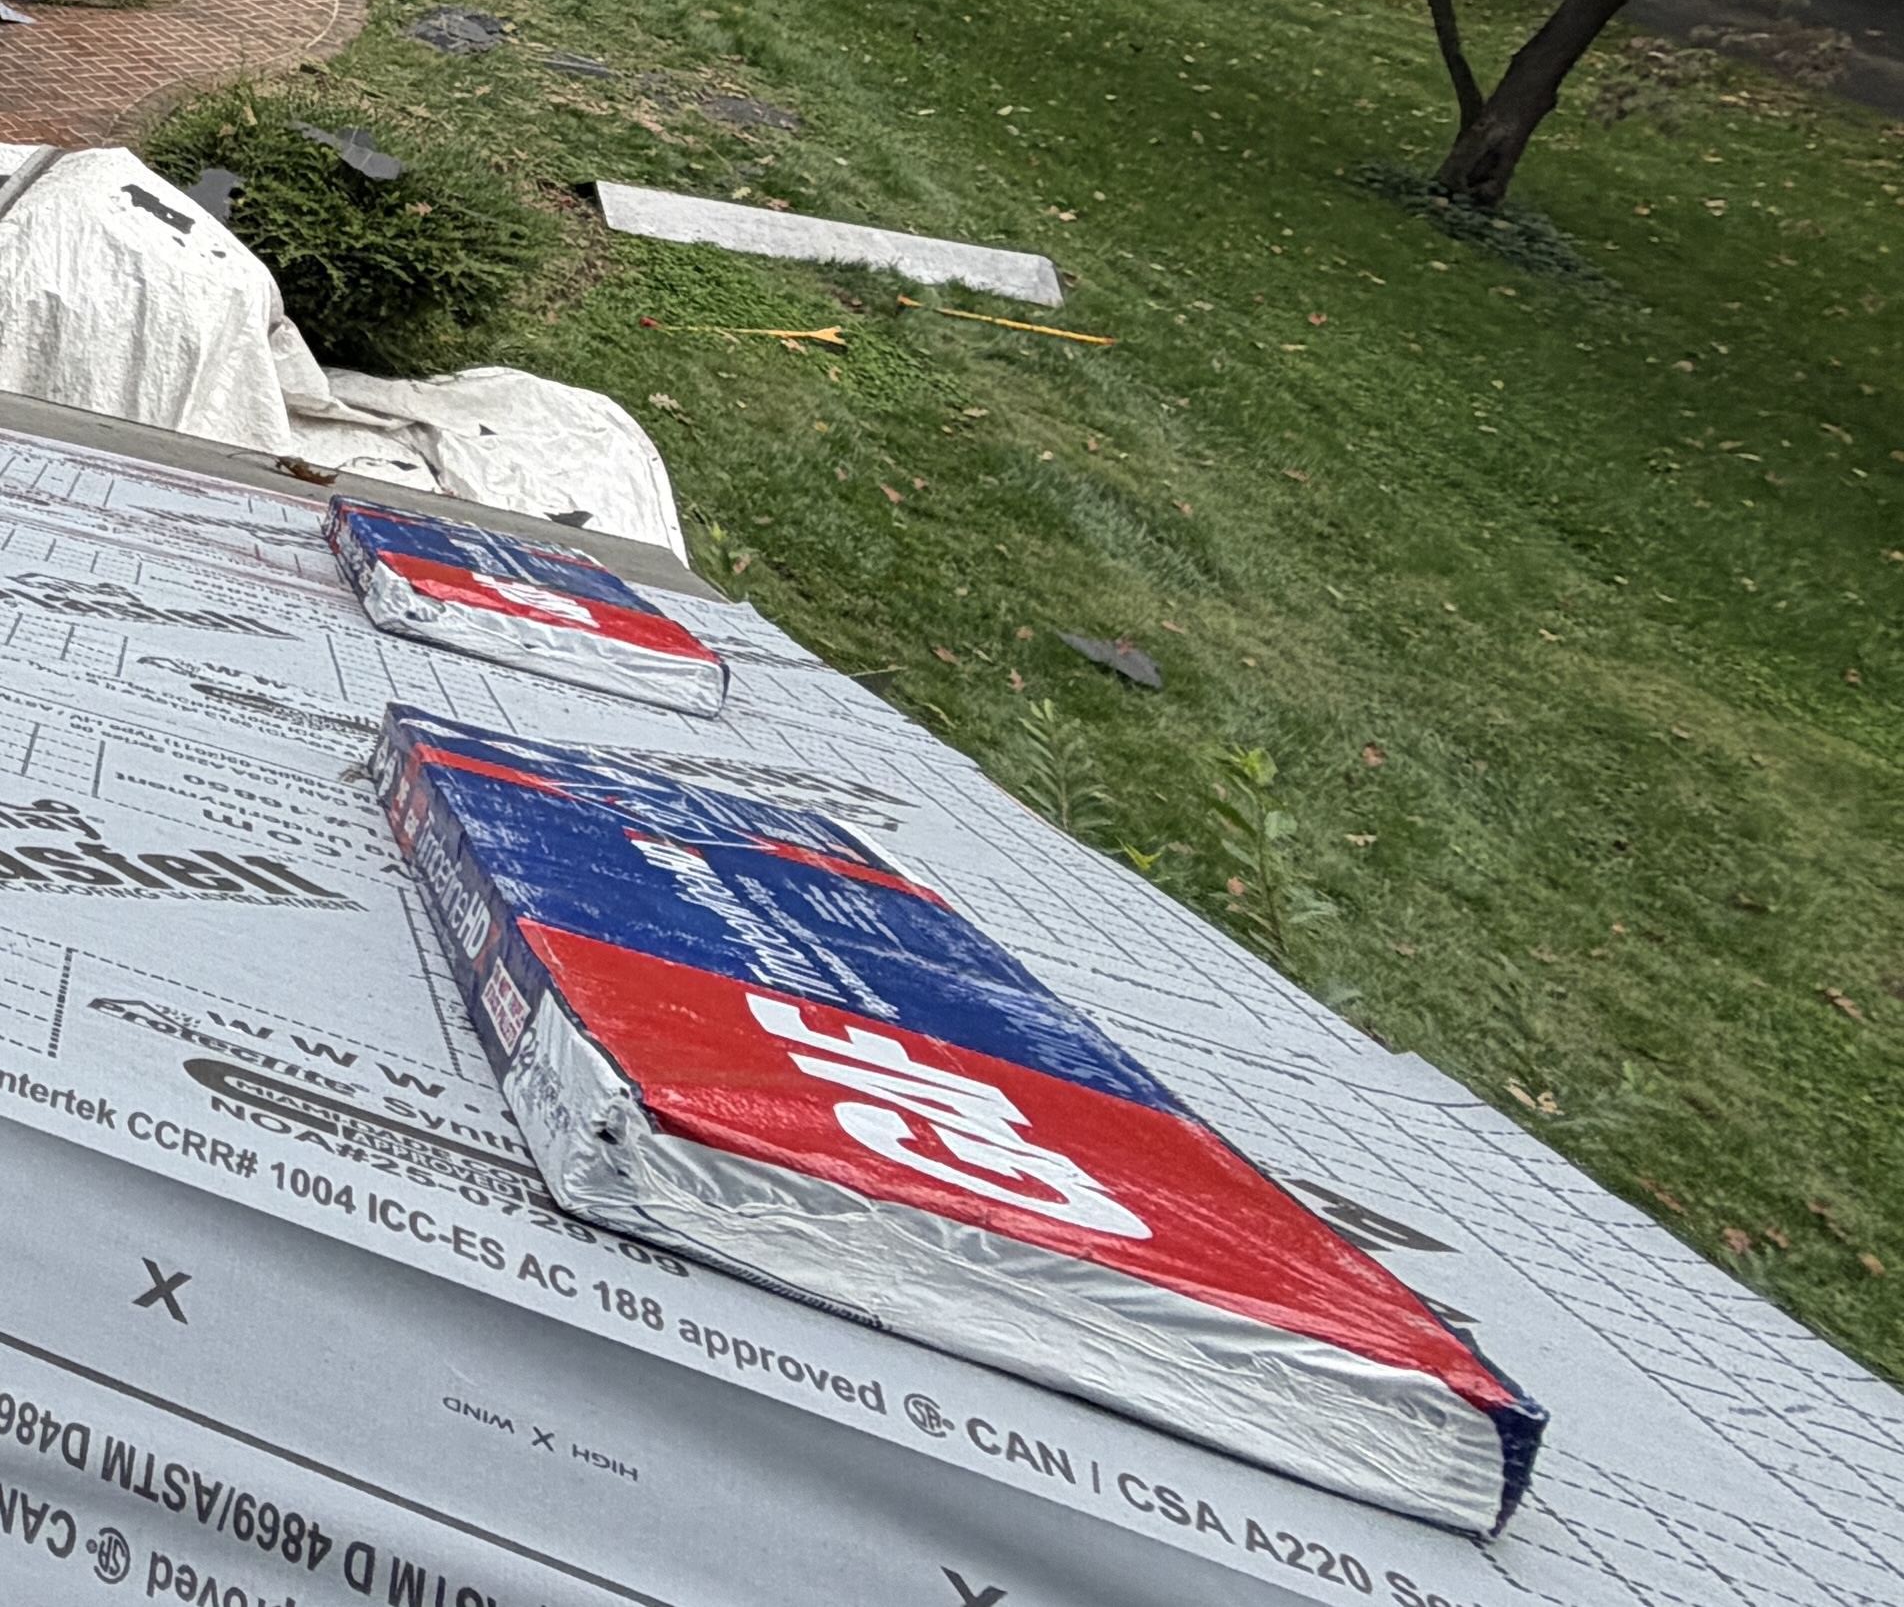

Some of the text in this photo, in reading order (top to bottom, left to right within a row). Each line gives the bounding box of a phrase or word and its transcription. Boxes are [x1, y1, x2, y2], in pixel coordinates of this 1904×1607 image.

[742, 984, 1154, 1242] GAF
[126, 1109, 260, 1180] CCRR#
[269, 1159, 358, 1216] 1004
[367, 1196, 507, 1274] ICC-ES
[516, 1251, 580, 1299] AC
[592, 1279, 667, 1333] 188
[677, 1316, 889, 1418] approved
[965, 1420, 1078, 1486] CAN
[1118, 1471, 1235, 1548] CSA
[1244, 1517, 1374, 1599] A220
[441, 1393, 641, 1483] HIGH WIND
[100, 1434, 333, 1574] 4869/ASTM
